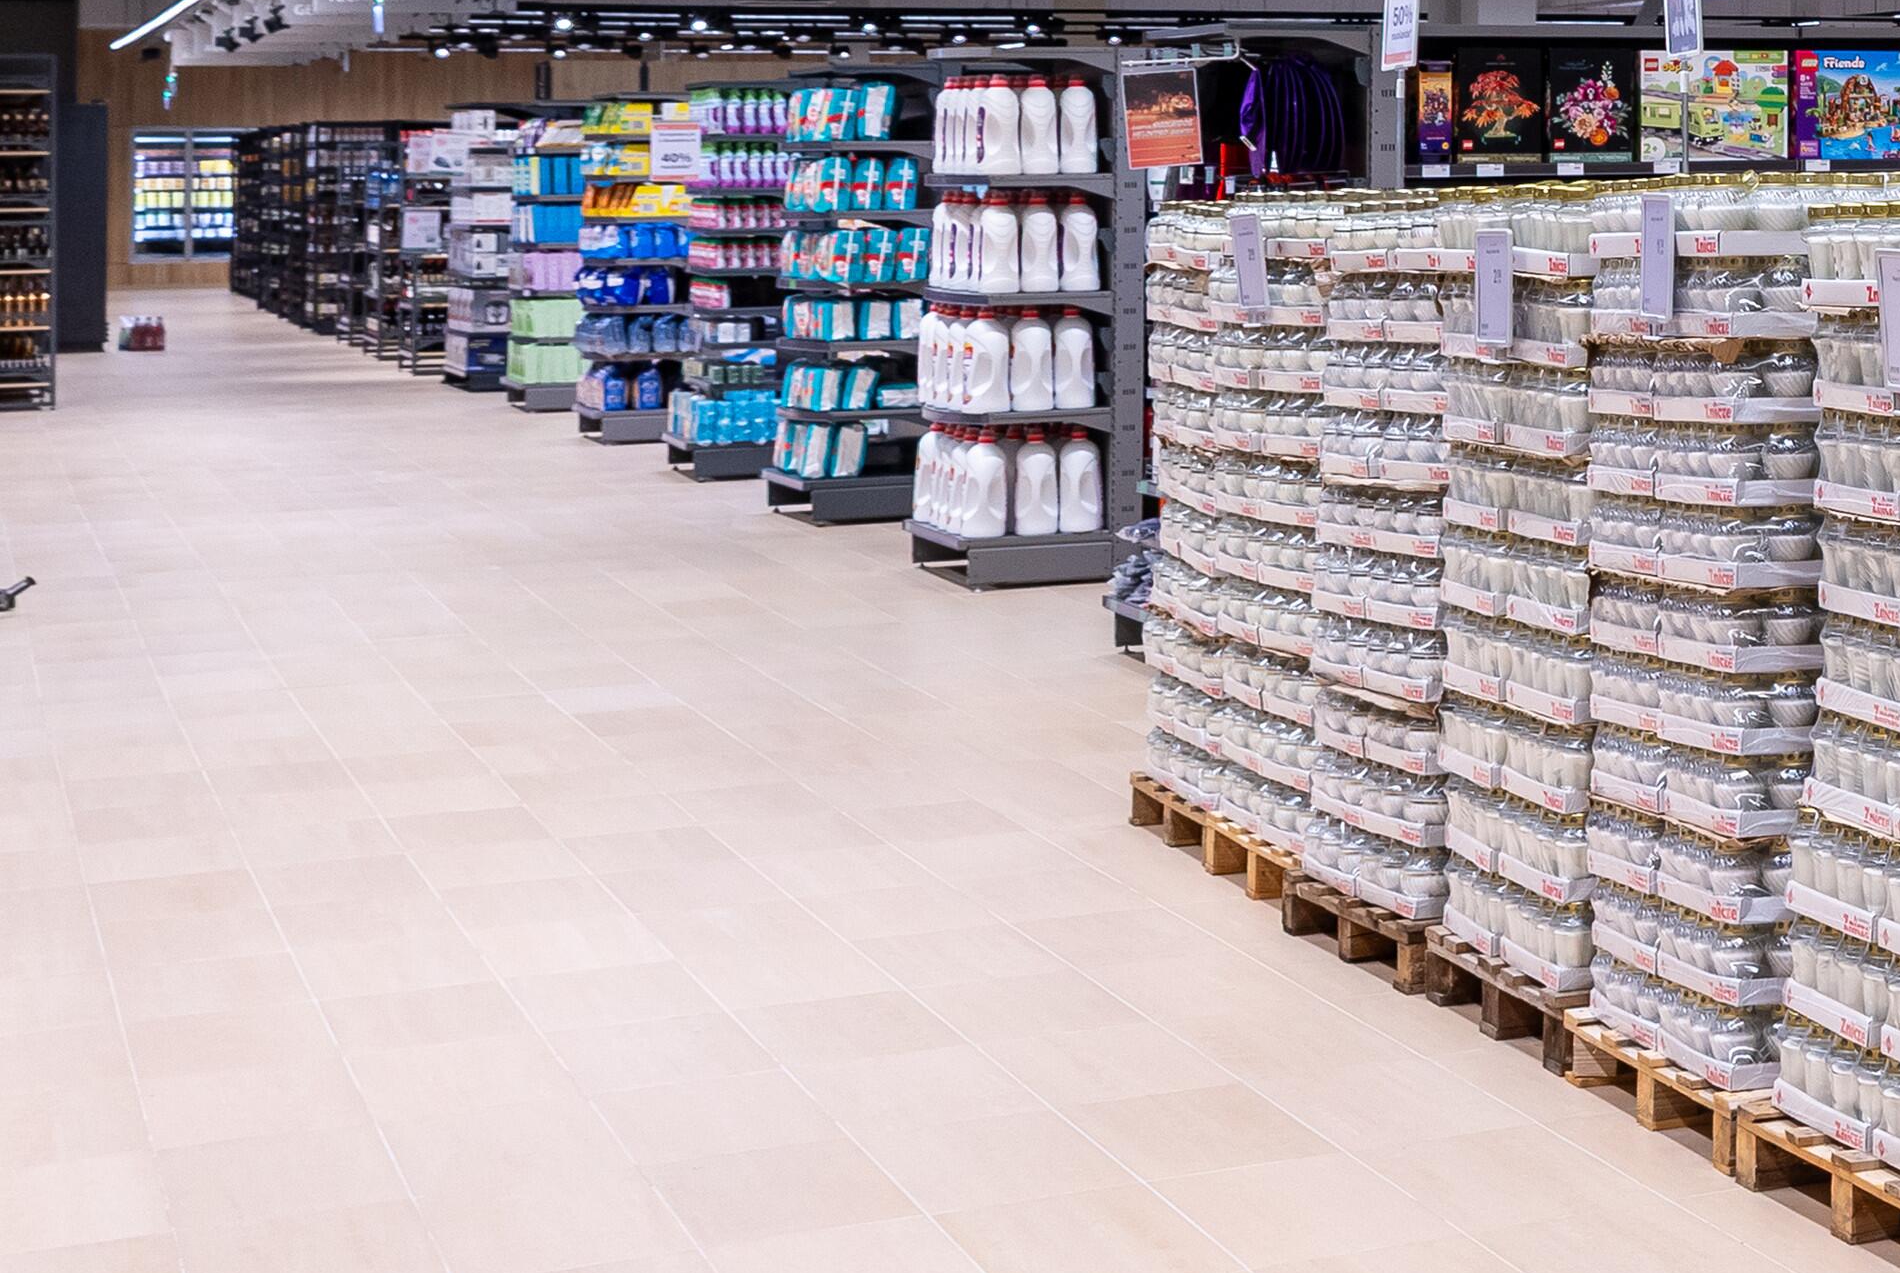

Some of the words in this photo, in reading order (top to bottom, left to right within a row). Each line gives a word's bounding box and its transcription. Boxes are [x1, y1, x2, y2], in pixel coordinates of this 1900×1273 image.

[1393, 5, 1413, 27] 50%
[1823, 56, 1866, 70] Friends
[661, 153, 692, 163] 40%
